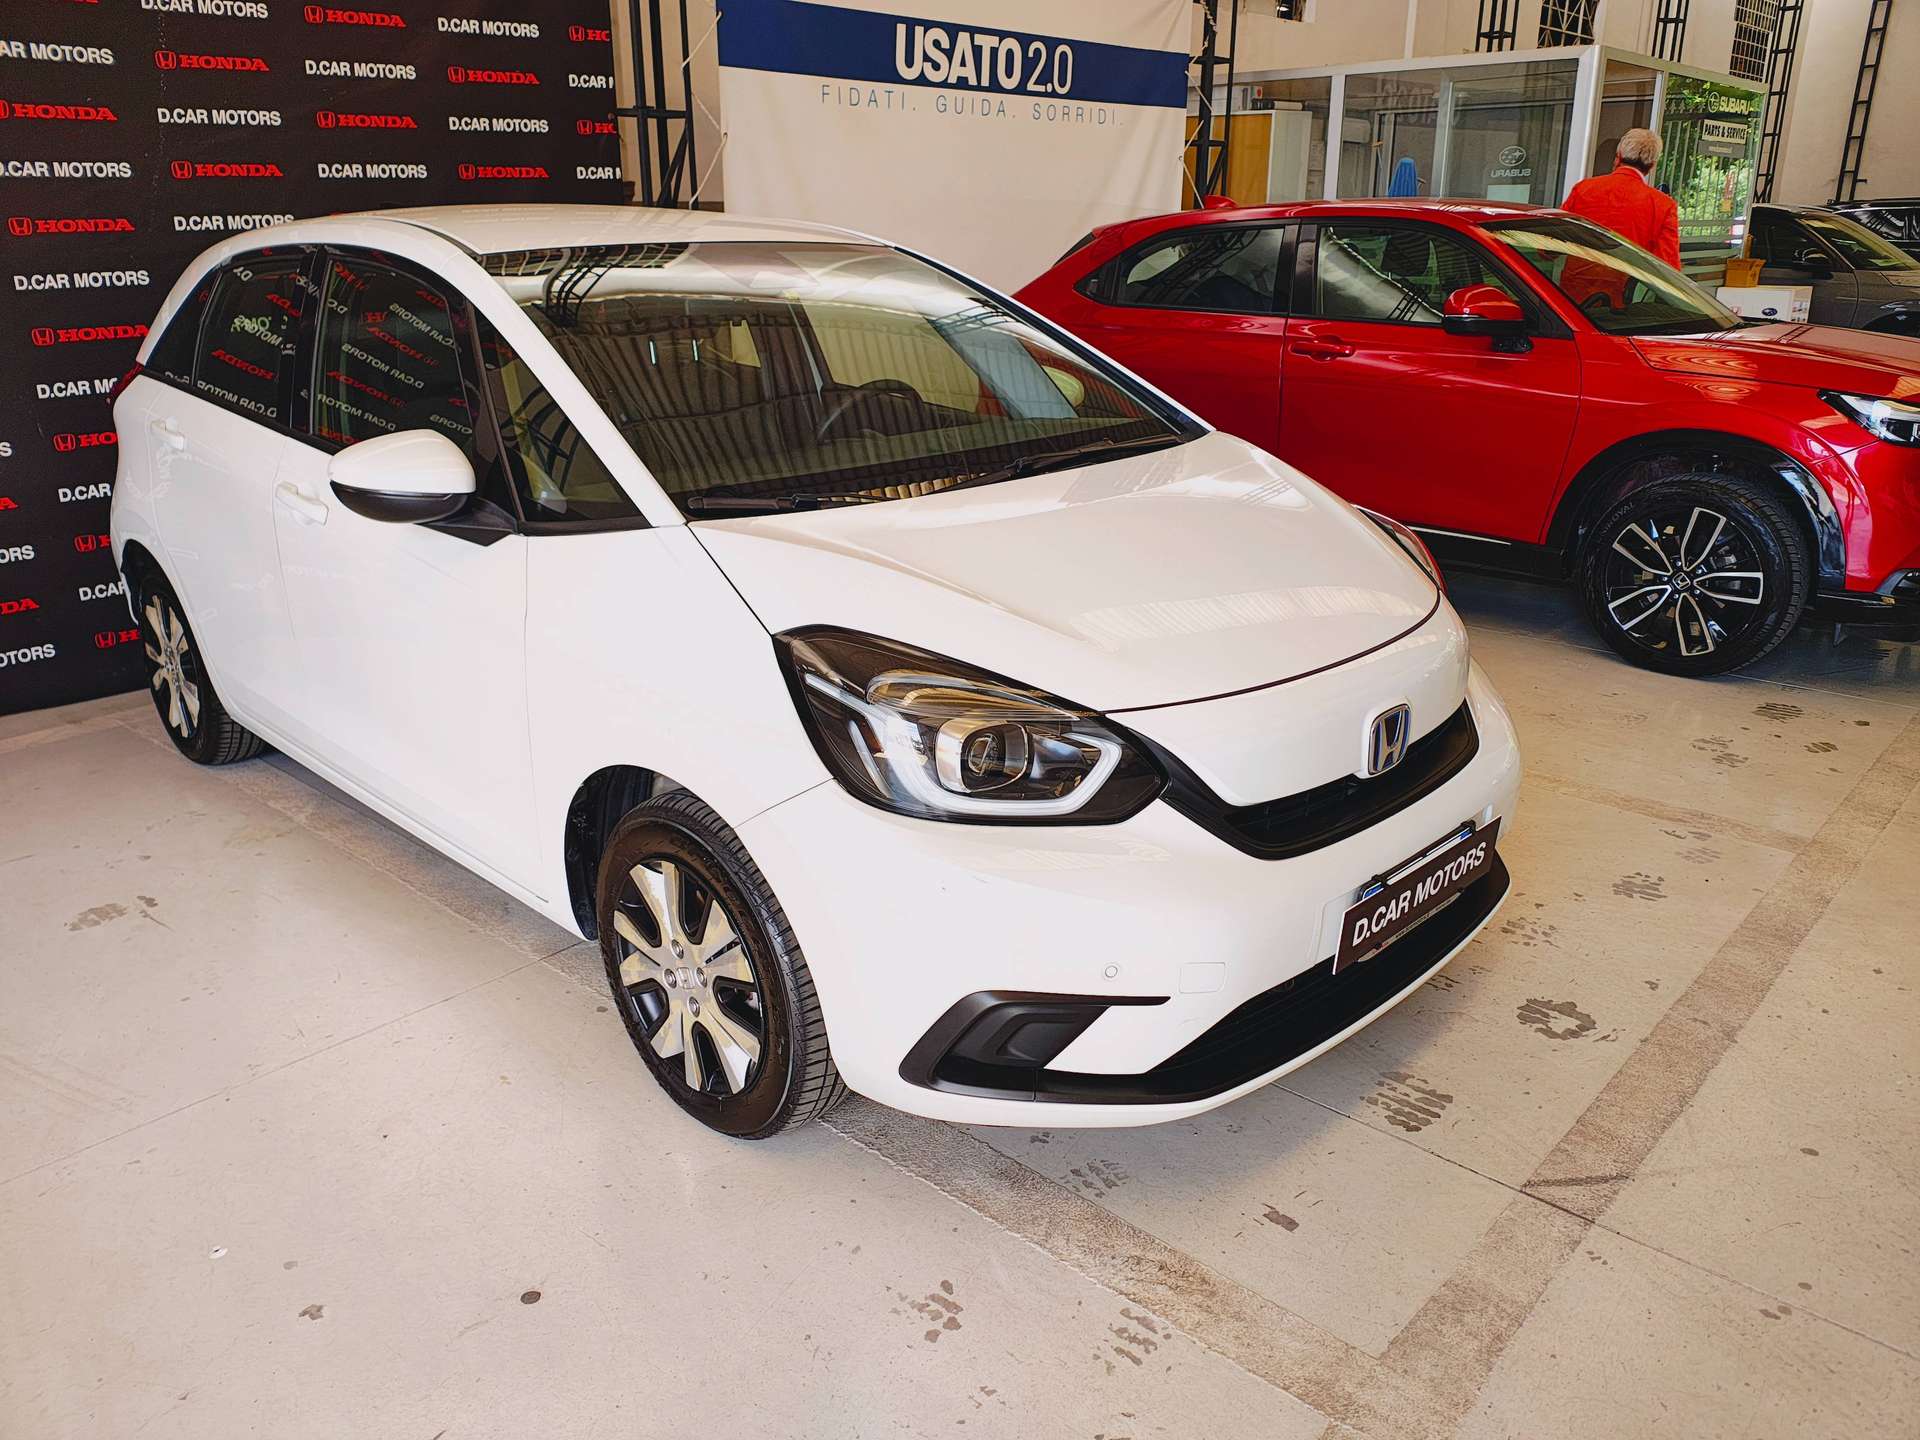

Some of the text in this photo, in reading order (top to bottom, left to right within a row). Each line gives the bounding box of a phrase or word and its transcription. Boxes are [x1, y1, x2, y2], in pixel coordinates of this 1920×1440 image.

[141, 0, 269, 19] D.CAR MOTORS
[326, 9, 407, 28] HONDA
[437, 17, 540, 38] D.CAR MOTORS
[30, 41, 115, 65] MOTORS
[179, 54, 270, 72] HONDA
[305, 59, 417, 81] D.CAR MOTORS
[467, 69, 540, 85] HONDA
[568, 74, 607, 88] D.CAR
[14, 103, 118, 121] HONDA
[822, 84, 1124, 125] FIDATI. GUIDA. SORRIDI.
[157, 108, 282, 126] D.CAR MOTORS
[338, 113, 418, 129] HONDA
[449, 116, 549, 133] D.CAR MOTORS
[53, 161, 132, 178] MOTORS
[195, 163, 284, 177] HONDA
[318, 163, 427, 179] D.CAR MOTORS
[478, 165, 549, 179] HONDA
[576, 166, 614, 180] D.CAR
[35, 218, 135, 233] HONDA
[174, 216, 223, 232] D.CAR
[14, 270, 150, 290] D.CAR MOTORS
[57, 324, 150, 342] HONDA
[36, 380, 91, 399] D.CAR
[58, 483, 111, 502] D.CAR
[1352, 841, 1487, 947] D.CAR MOTORS
